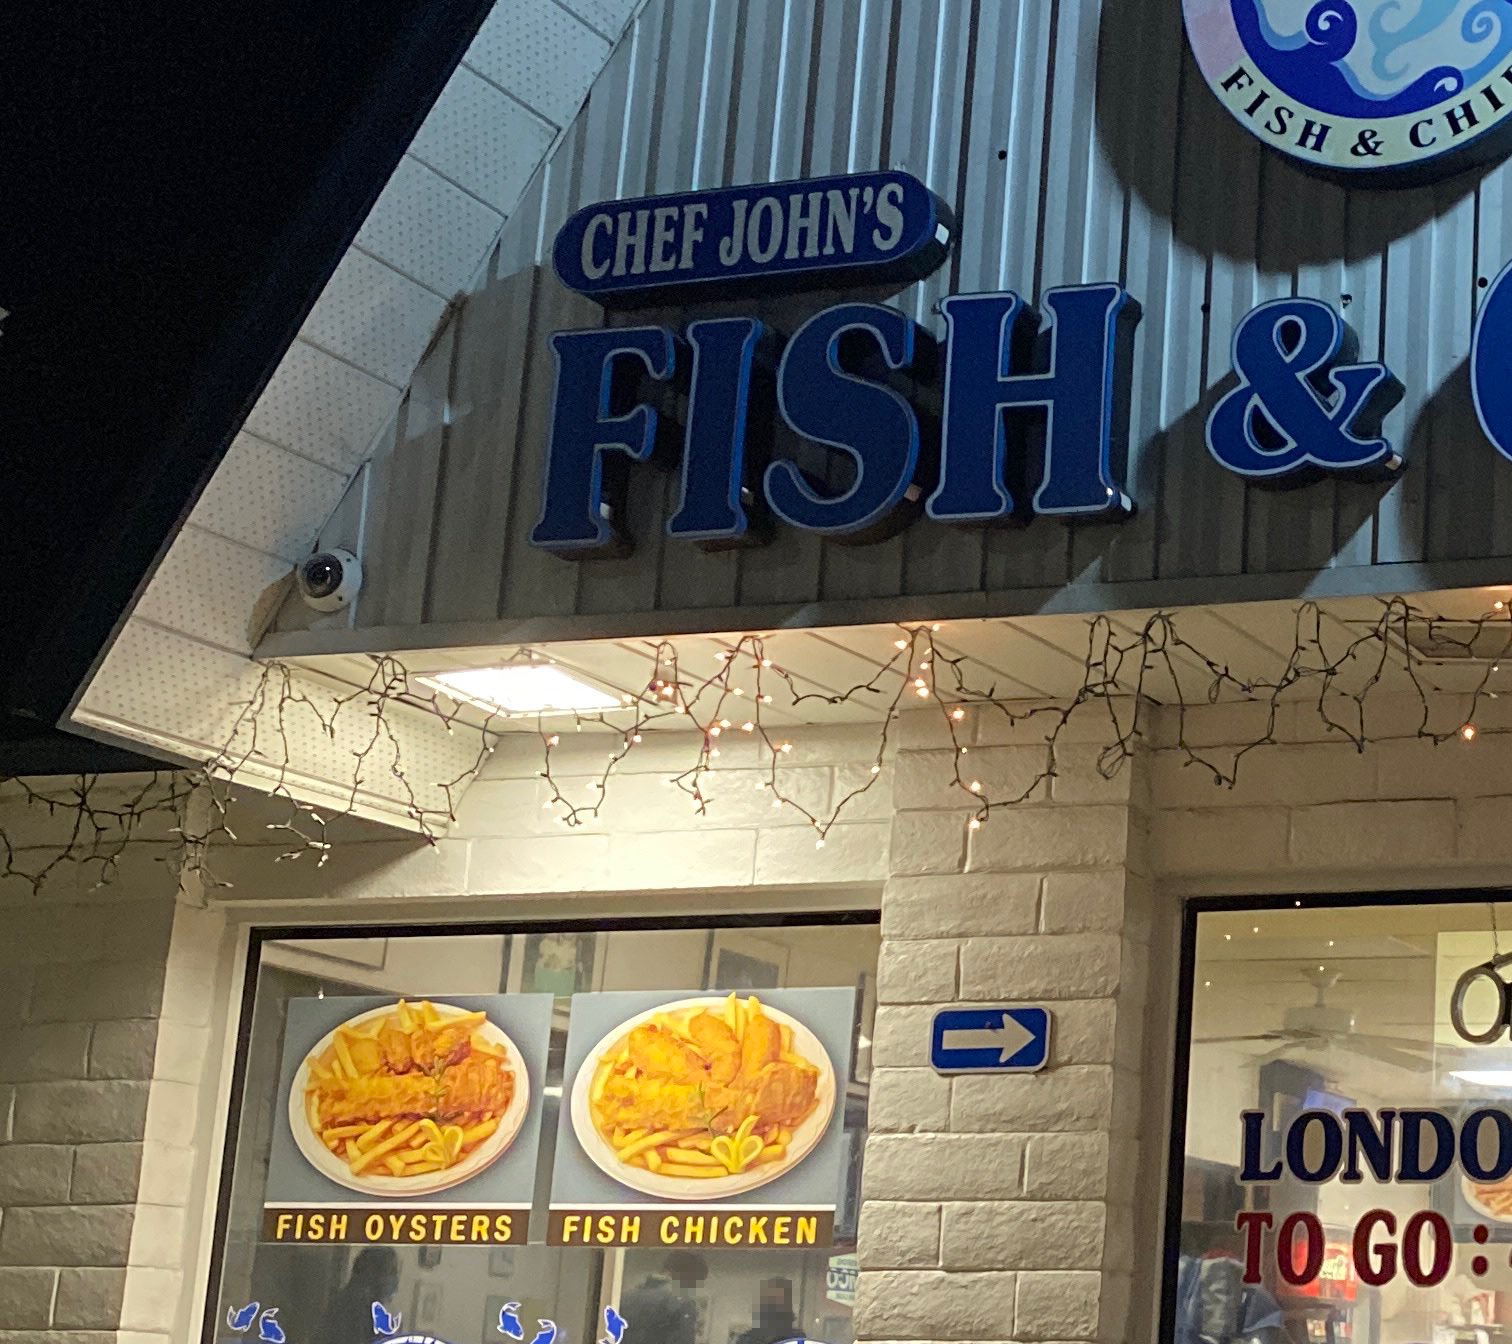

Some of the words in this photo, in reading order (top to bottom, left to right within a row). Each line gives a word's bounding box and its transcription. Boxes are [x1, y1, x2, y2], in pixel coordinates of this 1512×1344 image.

[1221, 64, 1332, 152] FISH
[1350, 129, 1385, 157] &
[581, 203, 708, 280] CHEF
[719, 182, 905, 263] JOHN'S
[529, 282, 1128, 548] FISH
[1205, 297, 1390, 476] &
[276, 1213, 347, 1240] FISH
[365, 1213, 513, 1243] OYSTERS
[562, 1215, 640, 1244] FISH
[660, 1215, 818, 1245] CHICKEN
[1236, 1210, 1325, 1287] TO
